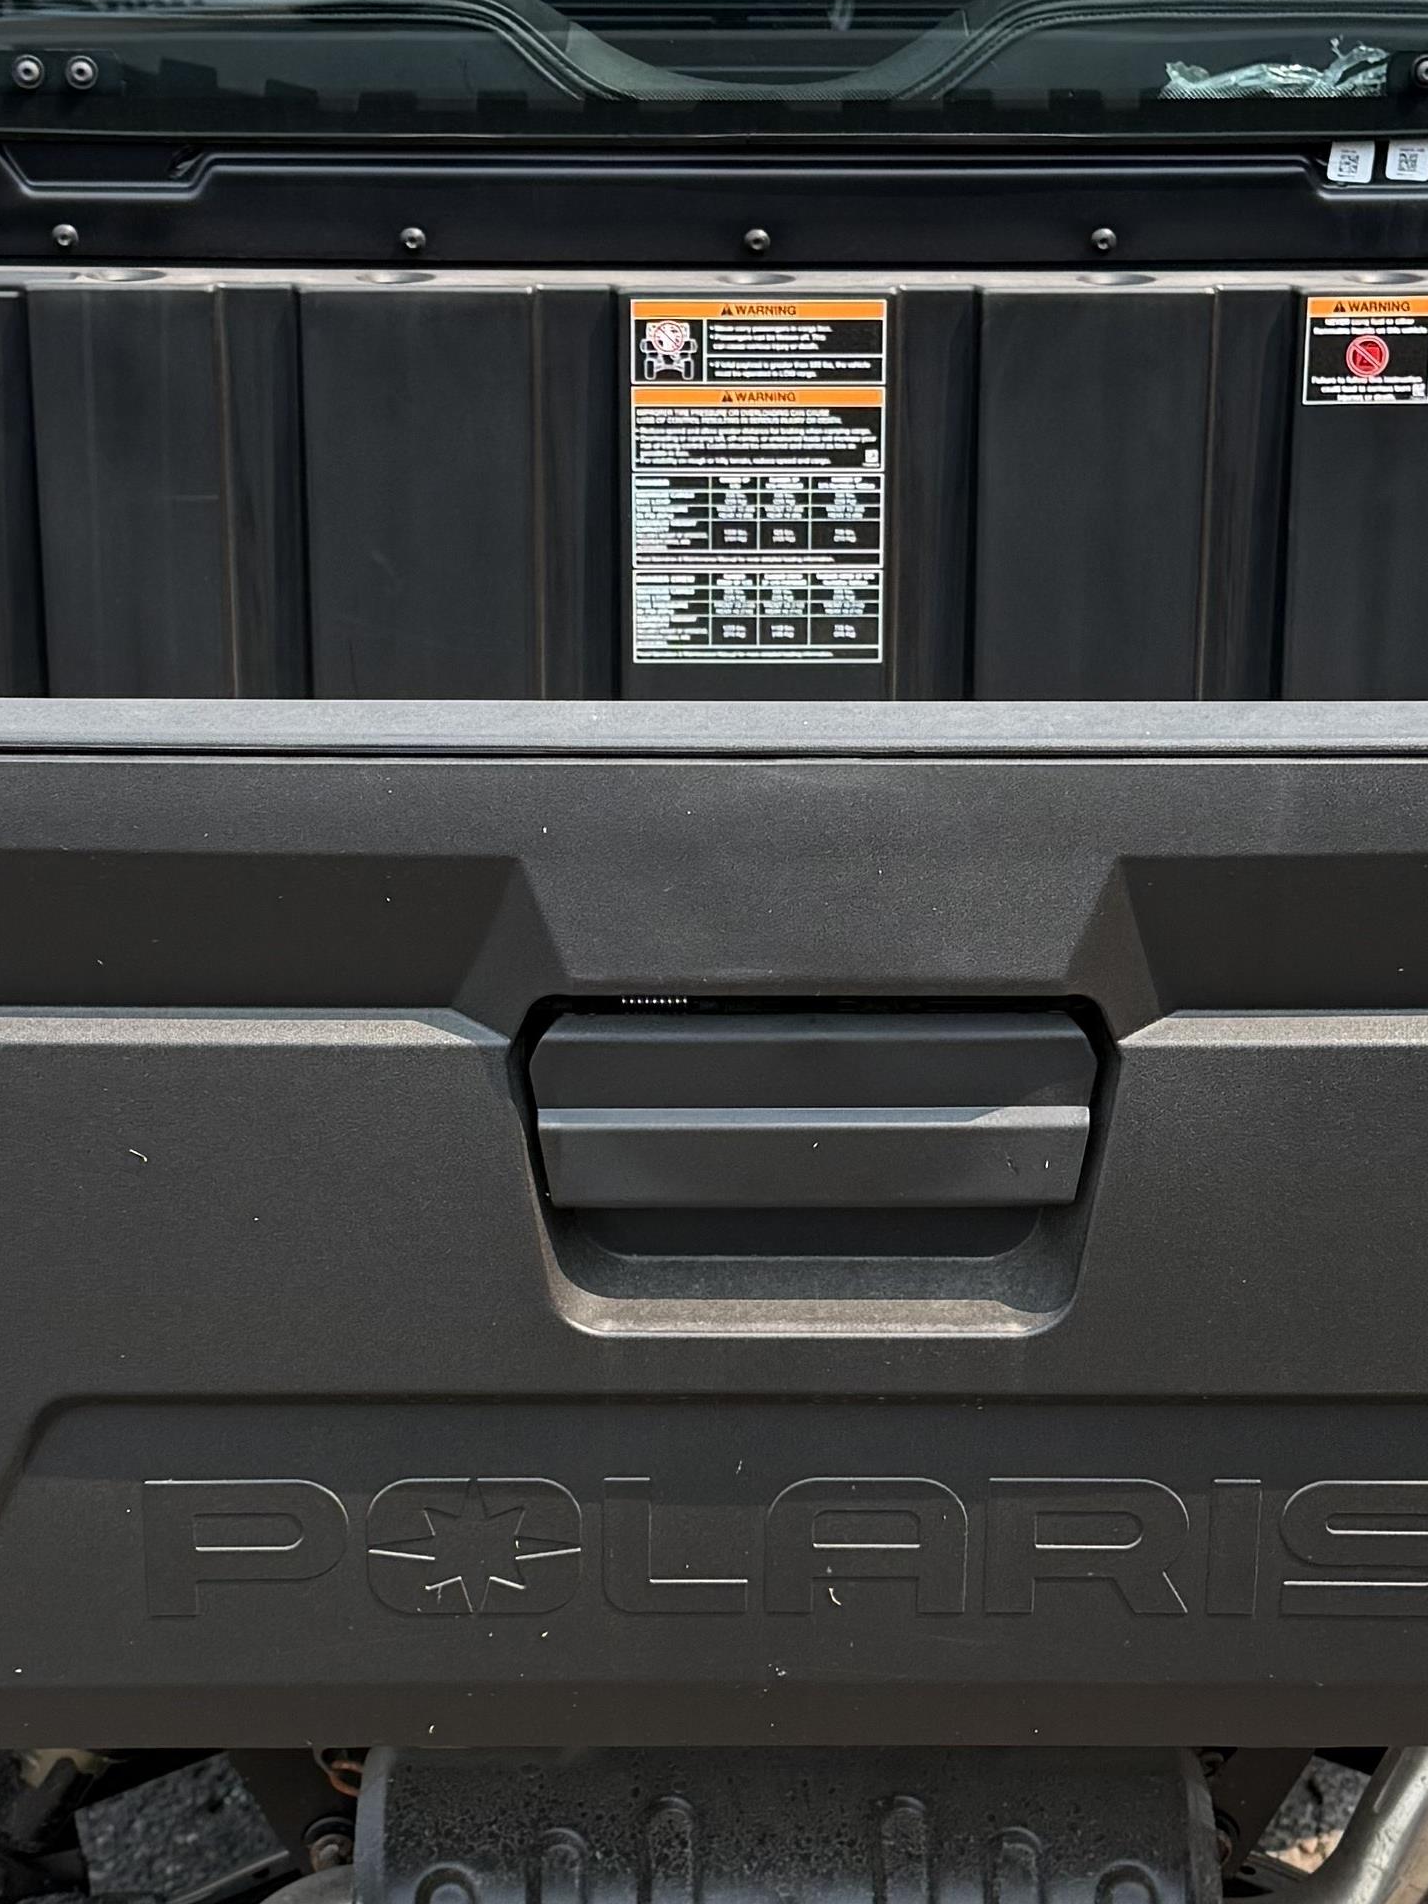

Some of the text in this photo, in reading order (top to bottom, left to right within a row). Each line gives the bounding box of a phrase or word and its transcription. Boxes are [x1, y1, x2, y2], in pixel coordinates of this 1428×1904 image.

[735, 305, 797, 316] WARNING
[1349, 301, 1411, 312] WARNING
[735, 391, 797, 402] WARNING
